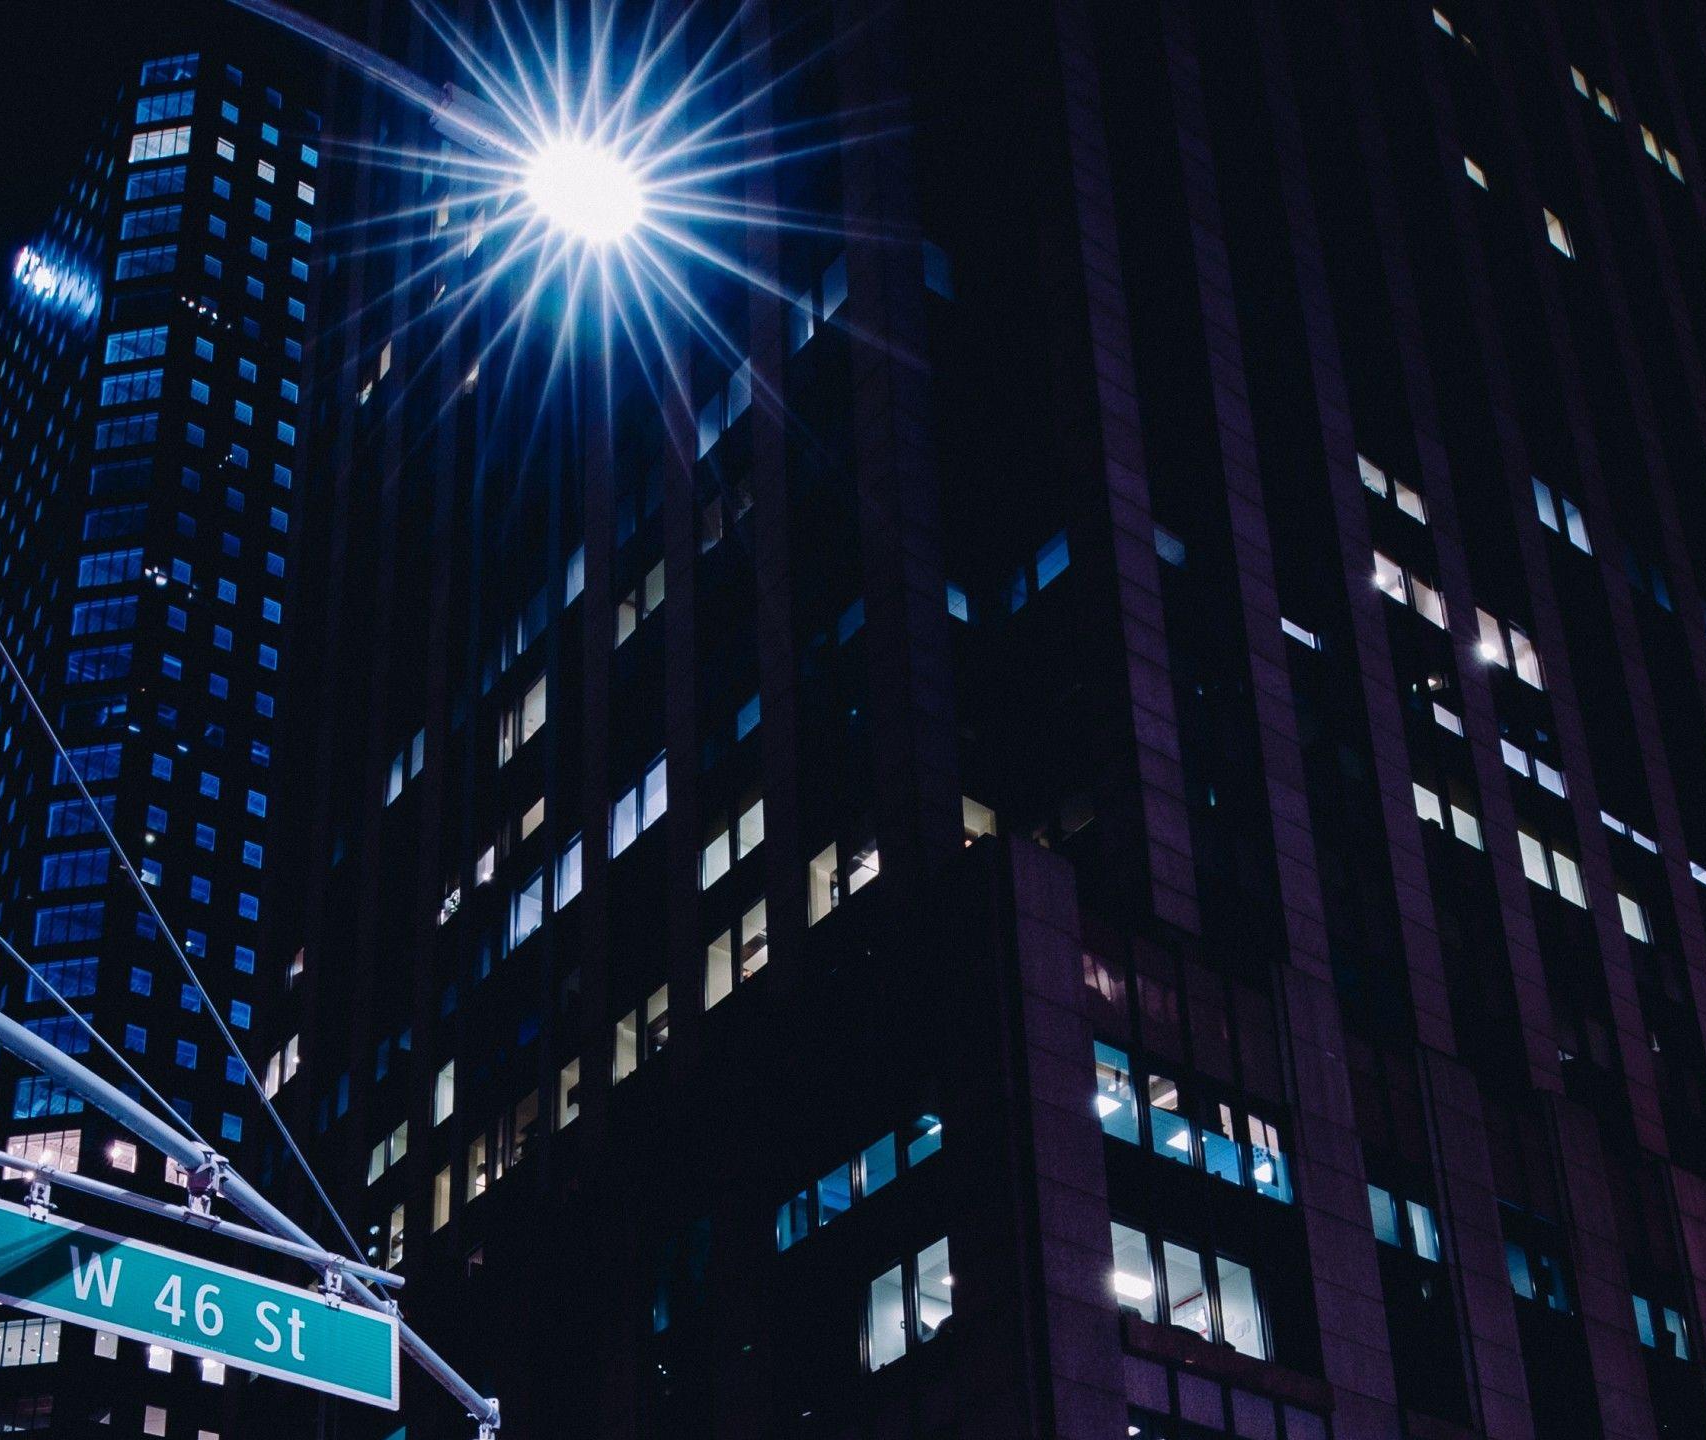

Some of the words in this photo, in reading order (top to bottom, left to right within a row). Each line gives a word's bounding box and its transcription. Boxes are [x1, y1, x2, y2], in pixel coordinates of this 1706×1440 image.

[70, 1245, 122, 1307] W
[154, 1274, 224, 1336] 46
[254, 1301, 306, 1361] St
